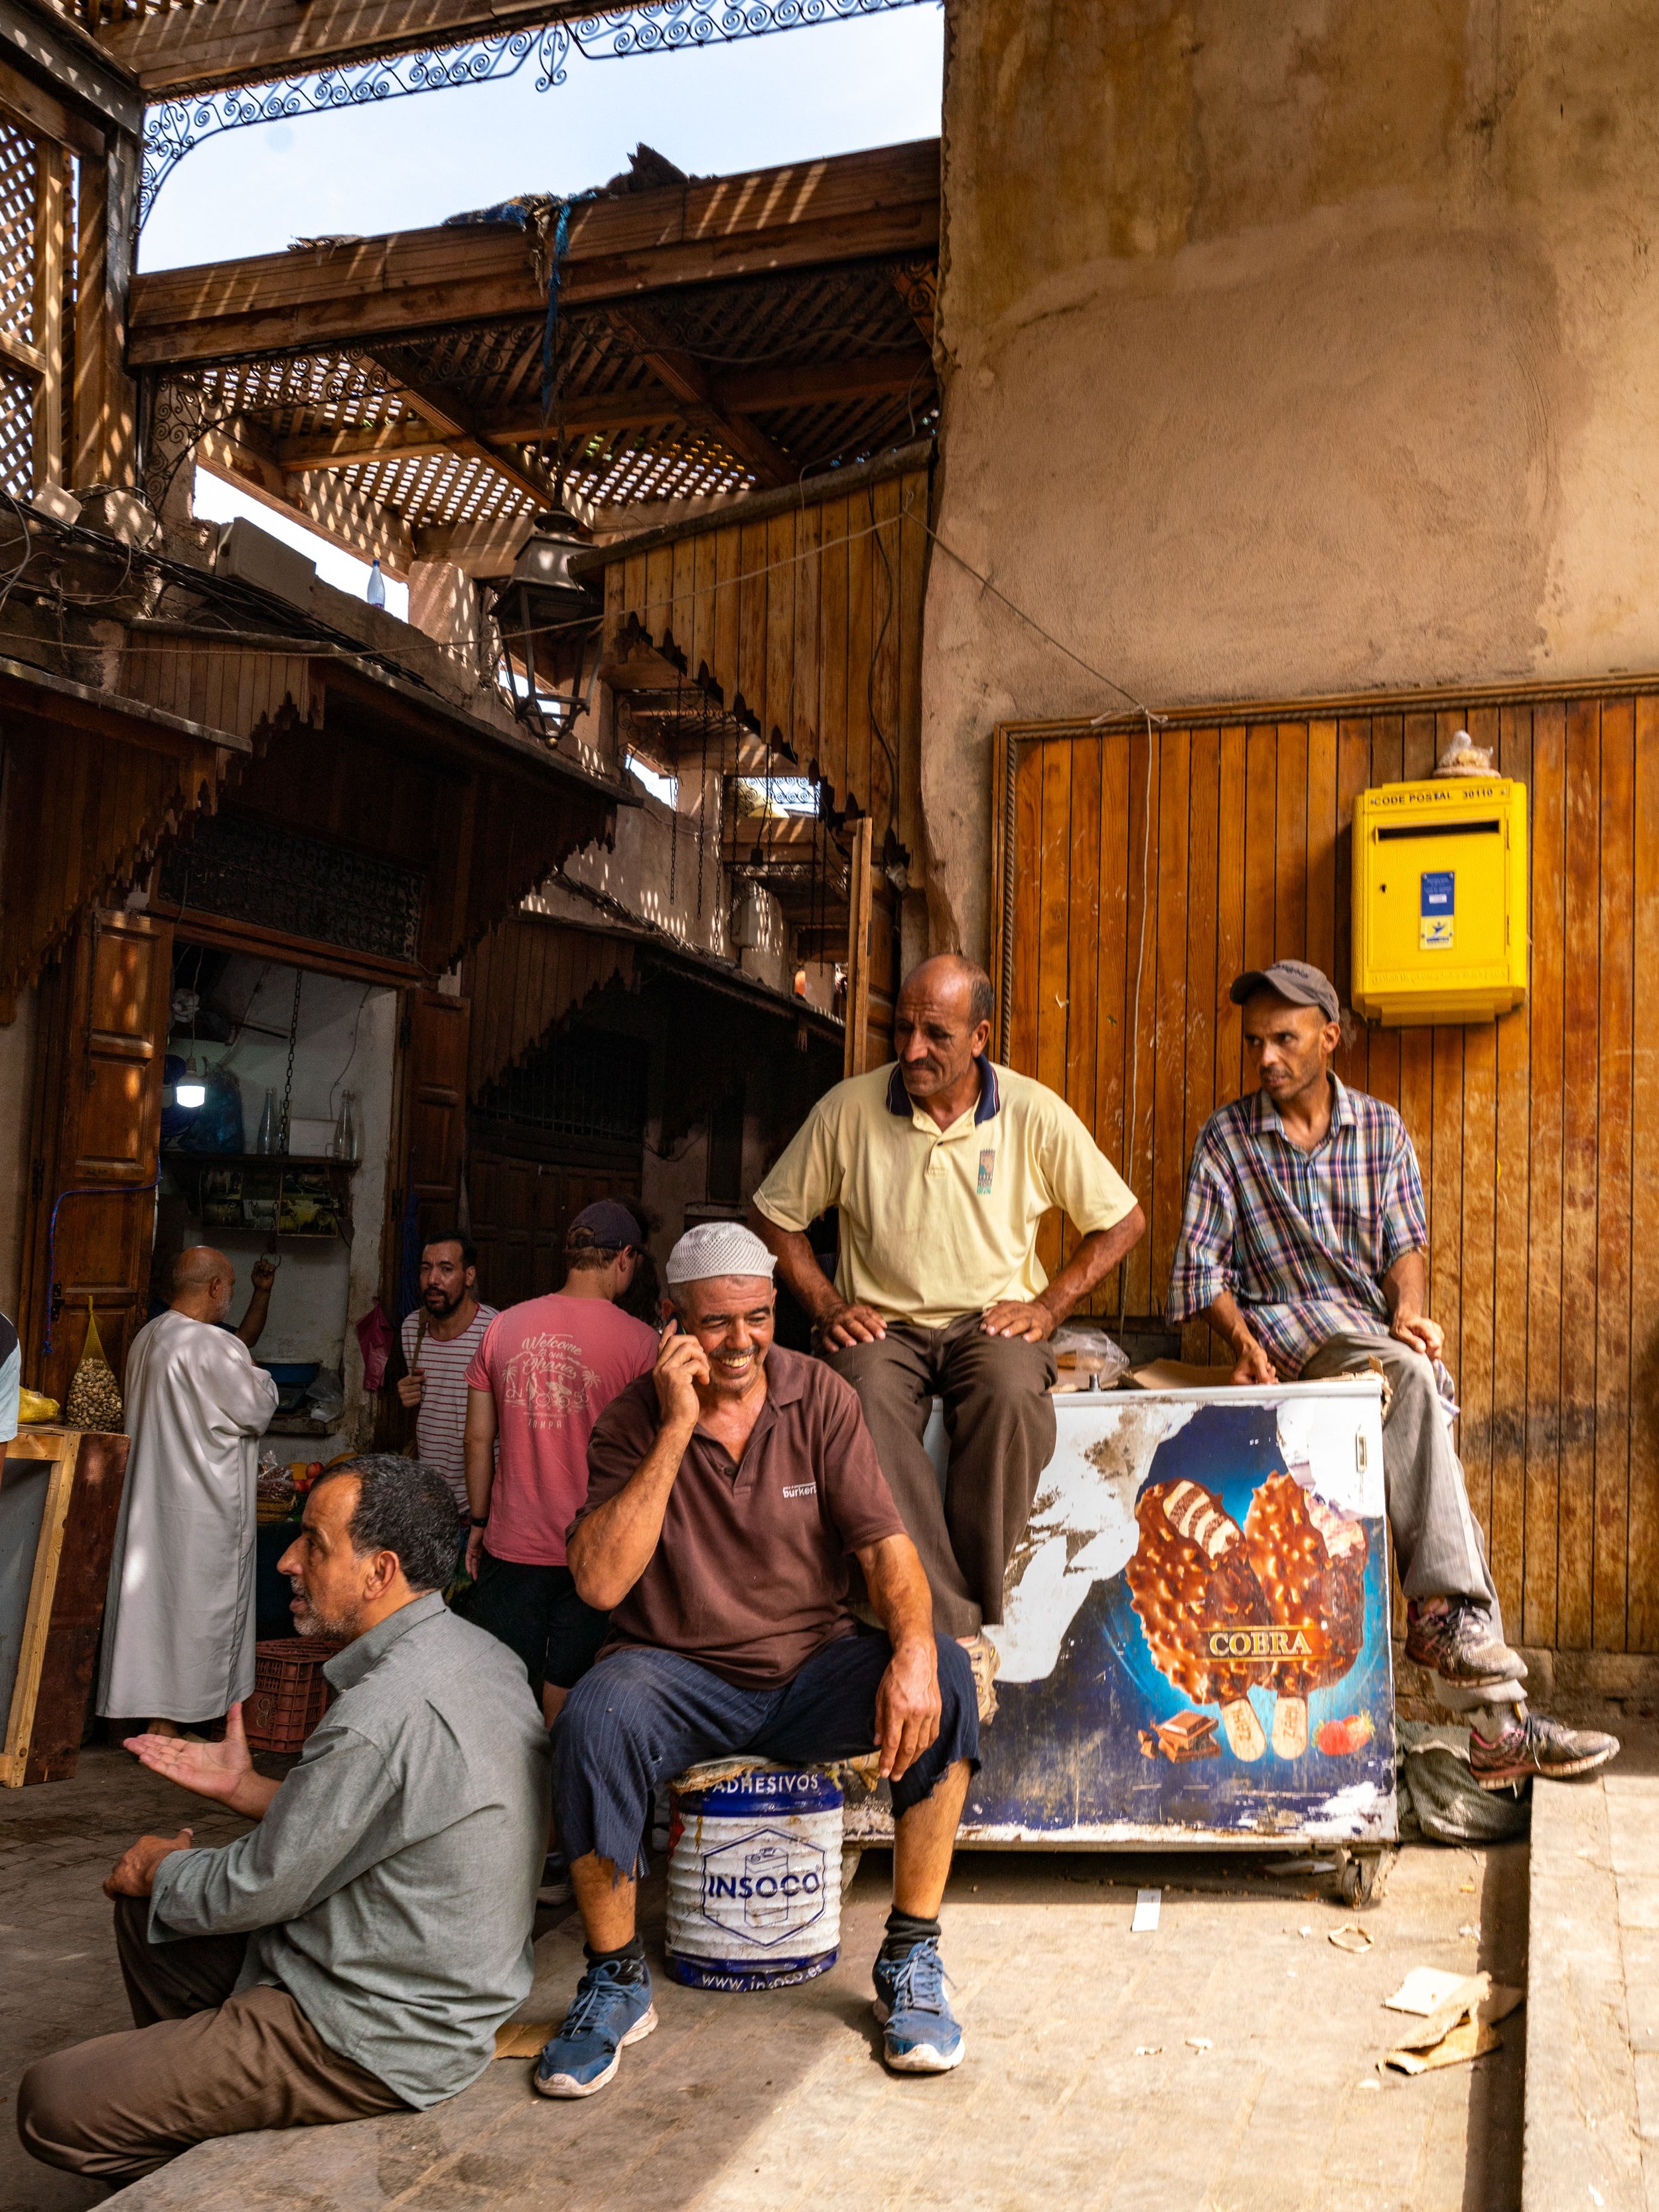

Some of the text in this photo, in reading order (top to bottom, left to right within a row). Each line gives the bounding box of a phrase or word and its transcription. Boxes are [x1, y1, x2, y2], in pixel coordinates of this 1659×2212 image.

[1374, 796, 1406, 806] CODE
[1409, 791, 1453, 804] POSTAL
[522, 1332, 582, 1355] Welcome
[1209, 1630, 1312, 1657] COBRA
[712, 1773, 819, 1794] ADHESIVOS
[708, 1872, 820, 1899] INSOCO
